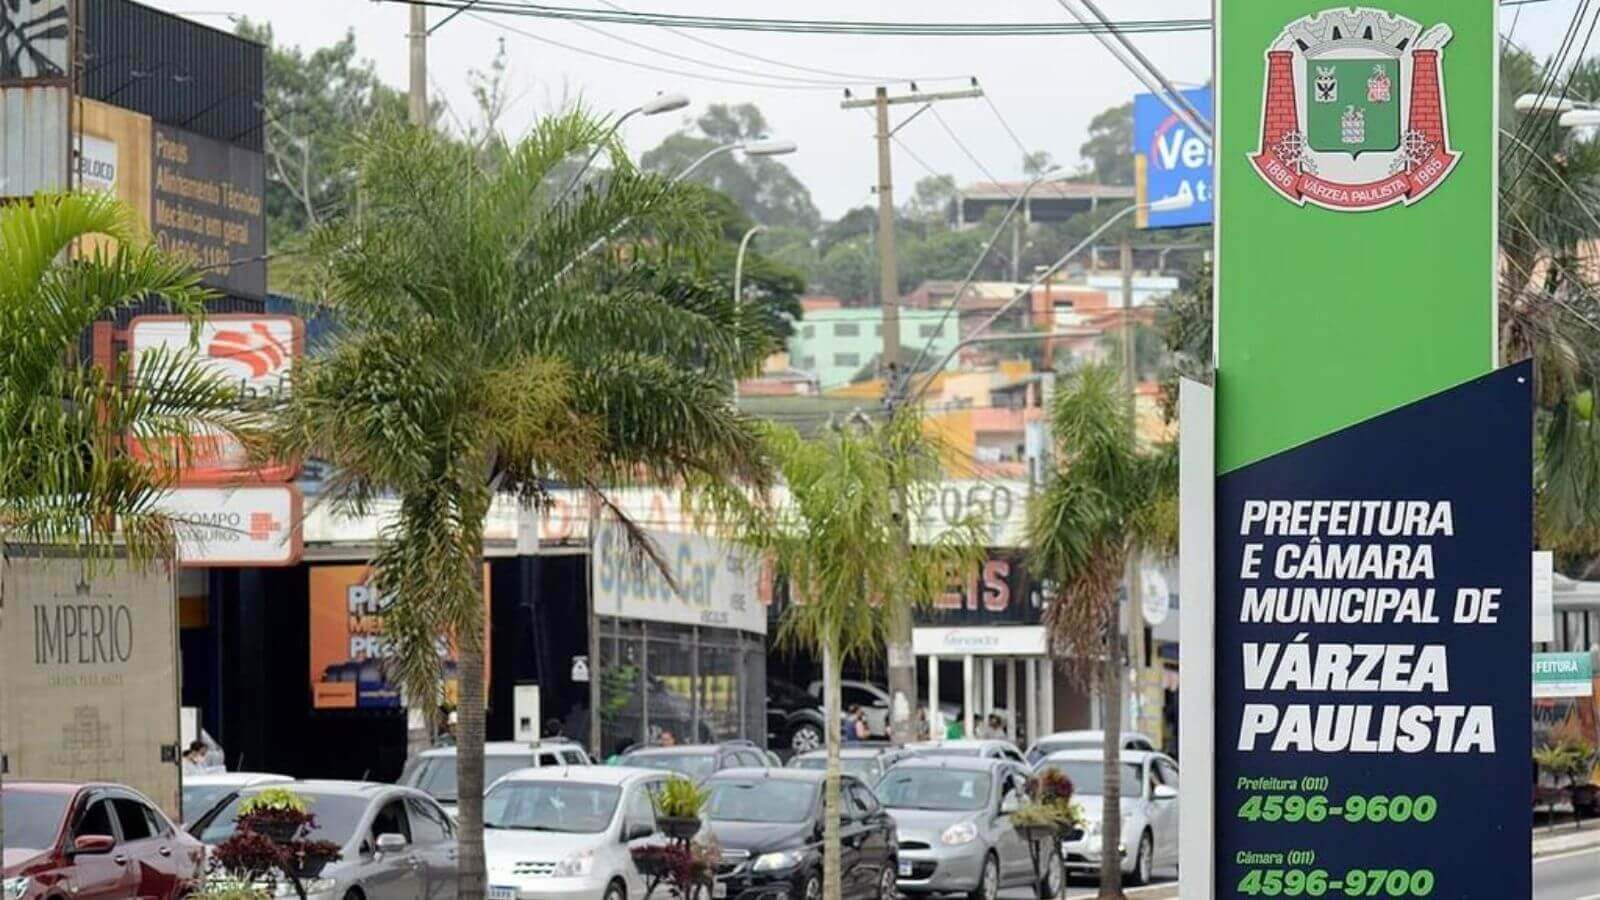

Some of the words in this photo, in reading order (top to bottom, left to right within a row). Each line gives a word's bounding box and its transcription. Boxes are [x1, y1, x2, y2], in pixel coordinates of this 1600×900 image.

[1303, 178, 1348, 202] VÁRZEA
[1351, 181, 1406, 203] PAULISTA
[1240, 500, 1453, 536] PREFEITURA
[1240, 544, 1263, 579] E
[1274, 537, 1434, 579] CÂMARA
[1240, 588, 1439, 623] MUNICIPAL
[1454, 588, 1501, 623] DE
[1243, 633, 1448, 692] VÁRZEA
[1238, 704, 1495, 753] PAULISTA
[1237, 776, 1297, 790] Prefeitura
[1301, 776, 1329, 791] (011)
[1237, 795, 1437, 822] 4596-9600
[1237, 850, 1283, 865] Câmara
[1287, 850, 1315, 866] (011)
[1237, 869, 1434, 896] 4596-9700
